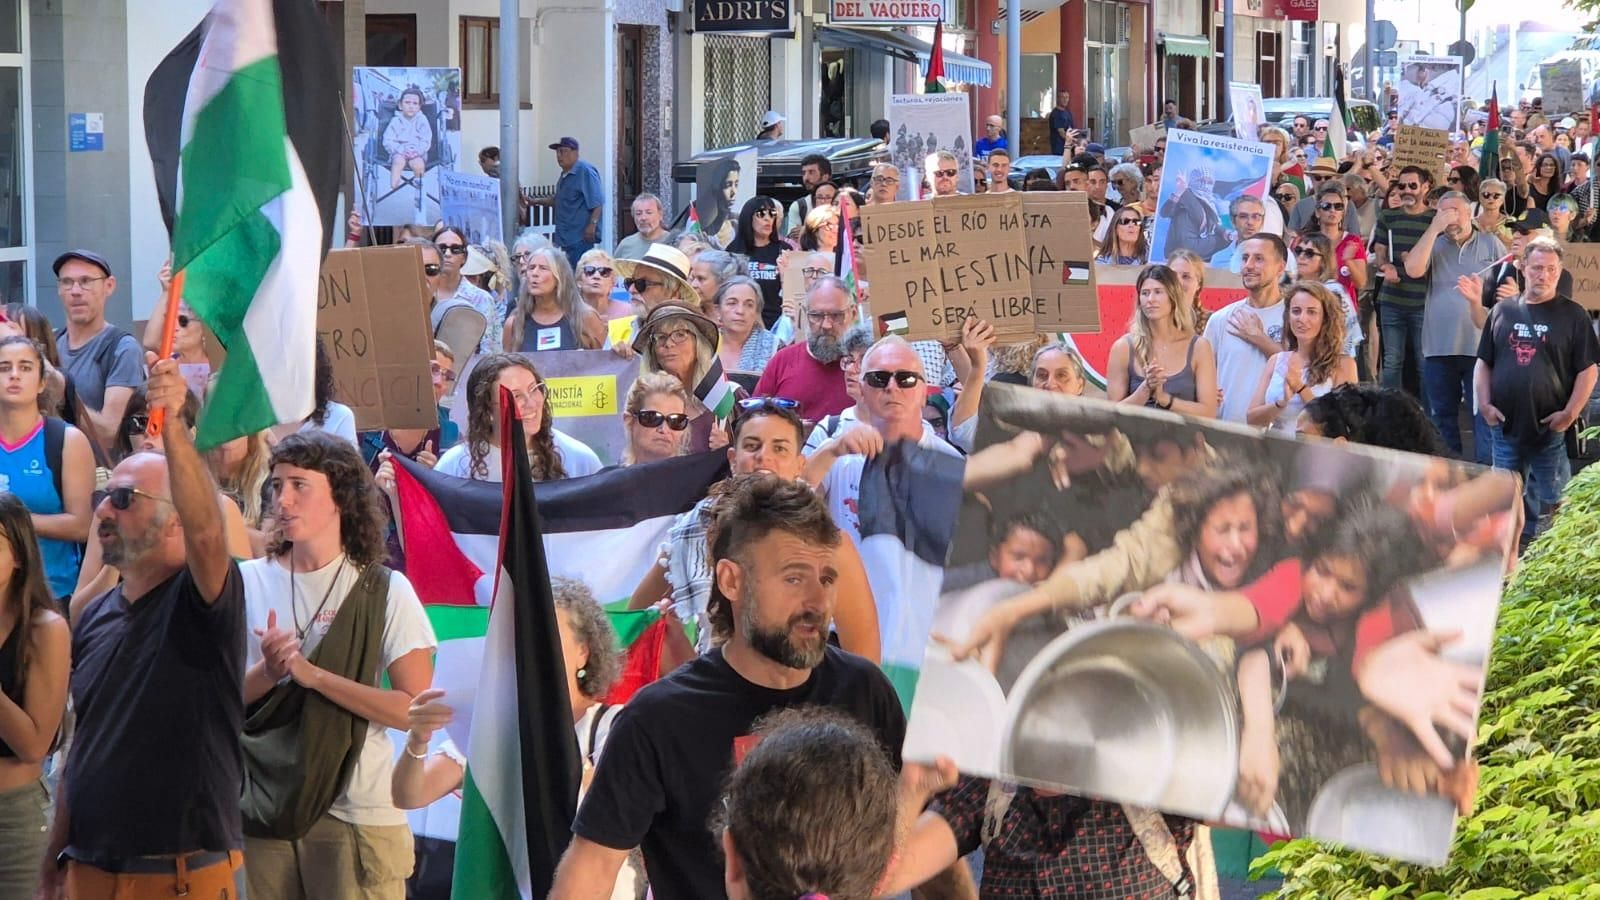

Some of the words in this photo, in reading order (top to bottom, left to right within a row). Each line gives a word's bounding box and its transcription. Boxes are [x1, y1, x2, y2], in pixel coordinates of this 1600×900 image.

[700, 1, 786, 22] ADRI'S
[836, 3, 864, 18] DEL
[869, 3, 941, 19] VAQUERO
[1177, 132, 1198, 144] Viva
[1200, 136, 1209, 146] la
[1210, 141, 1264, 154] resistencia
[867, 216, 925, 244] ¡DESDE
[933, 216, 952, 234] EL
[962, 210, 987, 231] RÍO
[1000, 213, 1052, 231] HASTA
[889, 250, 910, 265] EL
[920, 242, 960, 262] MAR
[905, 244, 1056, 307] PALESTINA
[931, 300, 978, 326] SERÁ
